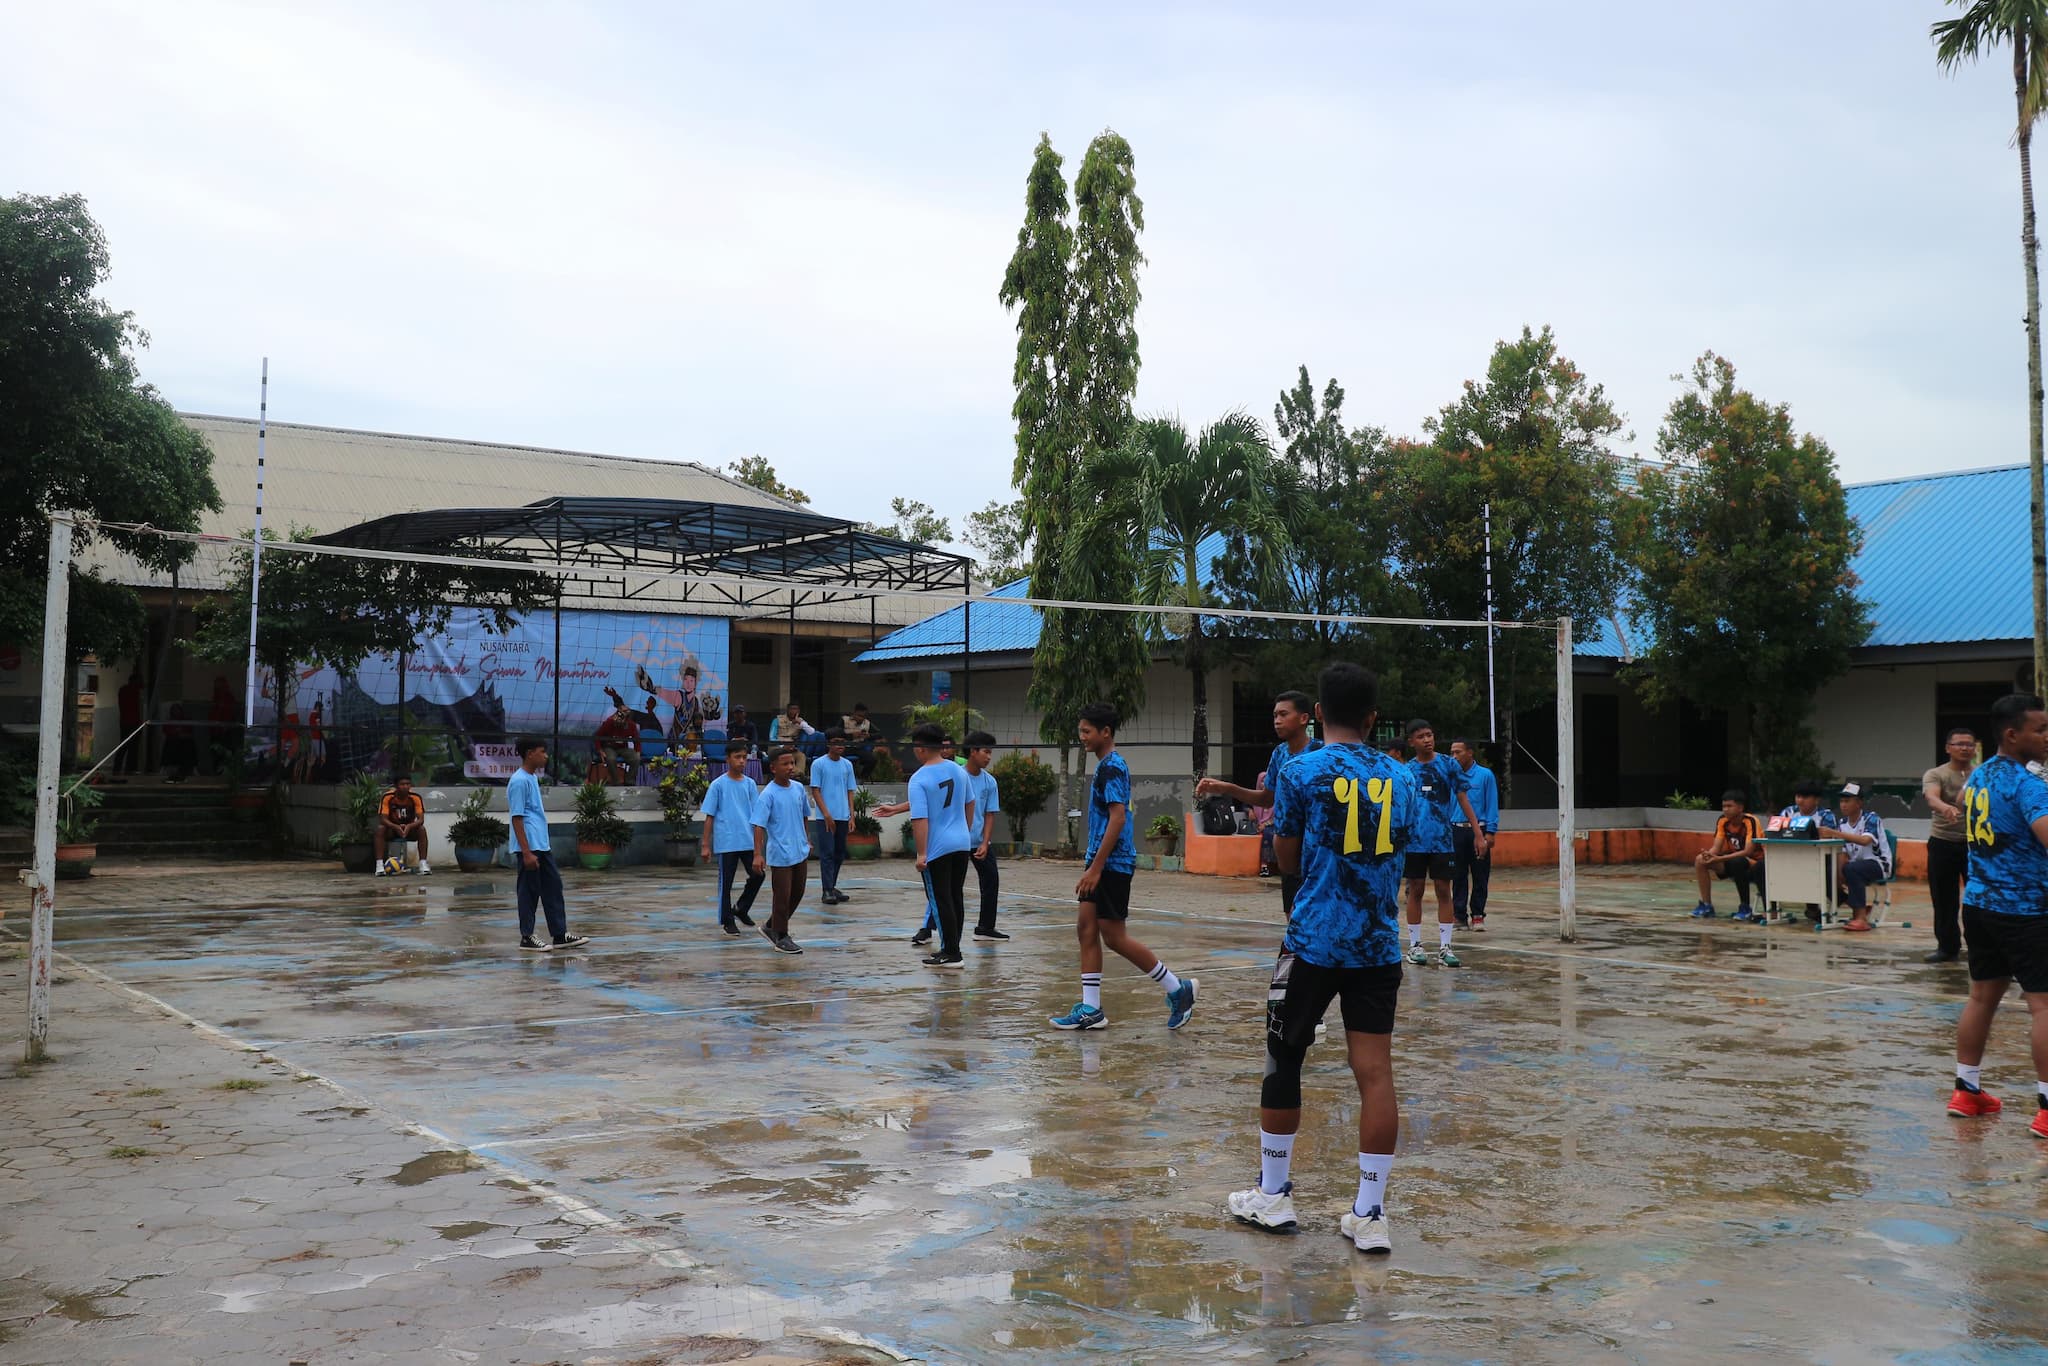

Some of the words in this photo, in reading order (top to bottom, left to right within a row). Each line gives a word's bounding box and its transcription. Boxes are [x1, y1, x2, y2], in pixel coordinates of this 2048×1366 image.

[480, 642, 530, 653] NUSANTARA
[534, 656, 610, 684] Nusantara
[938, 777, 955, 809] 7
[1965, 786, 1995, 847] 12
